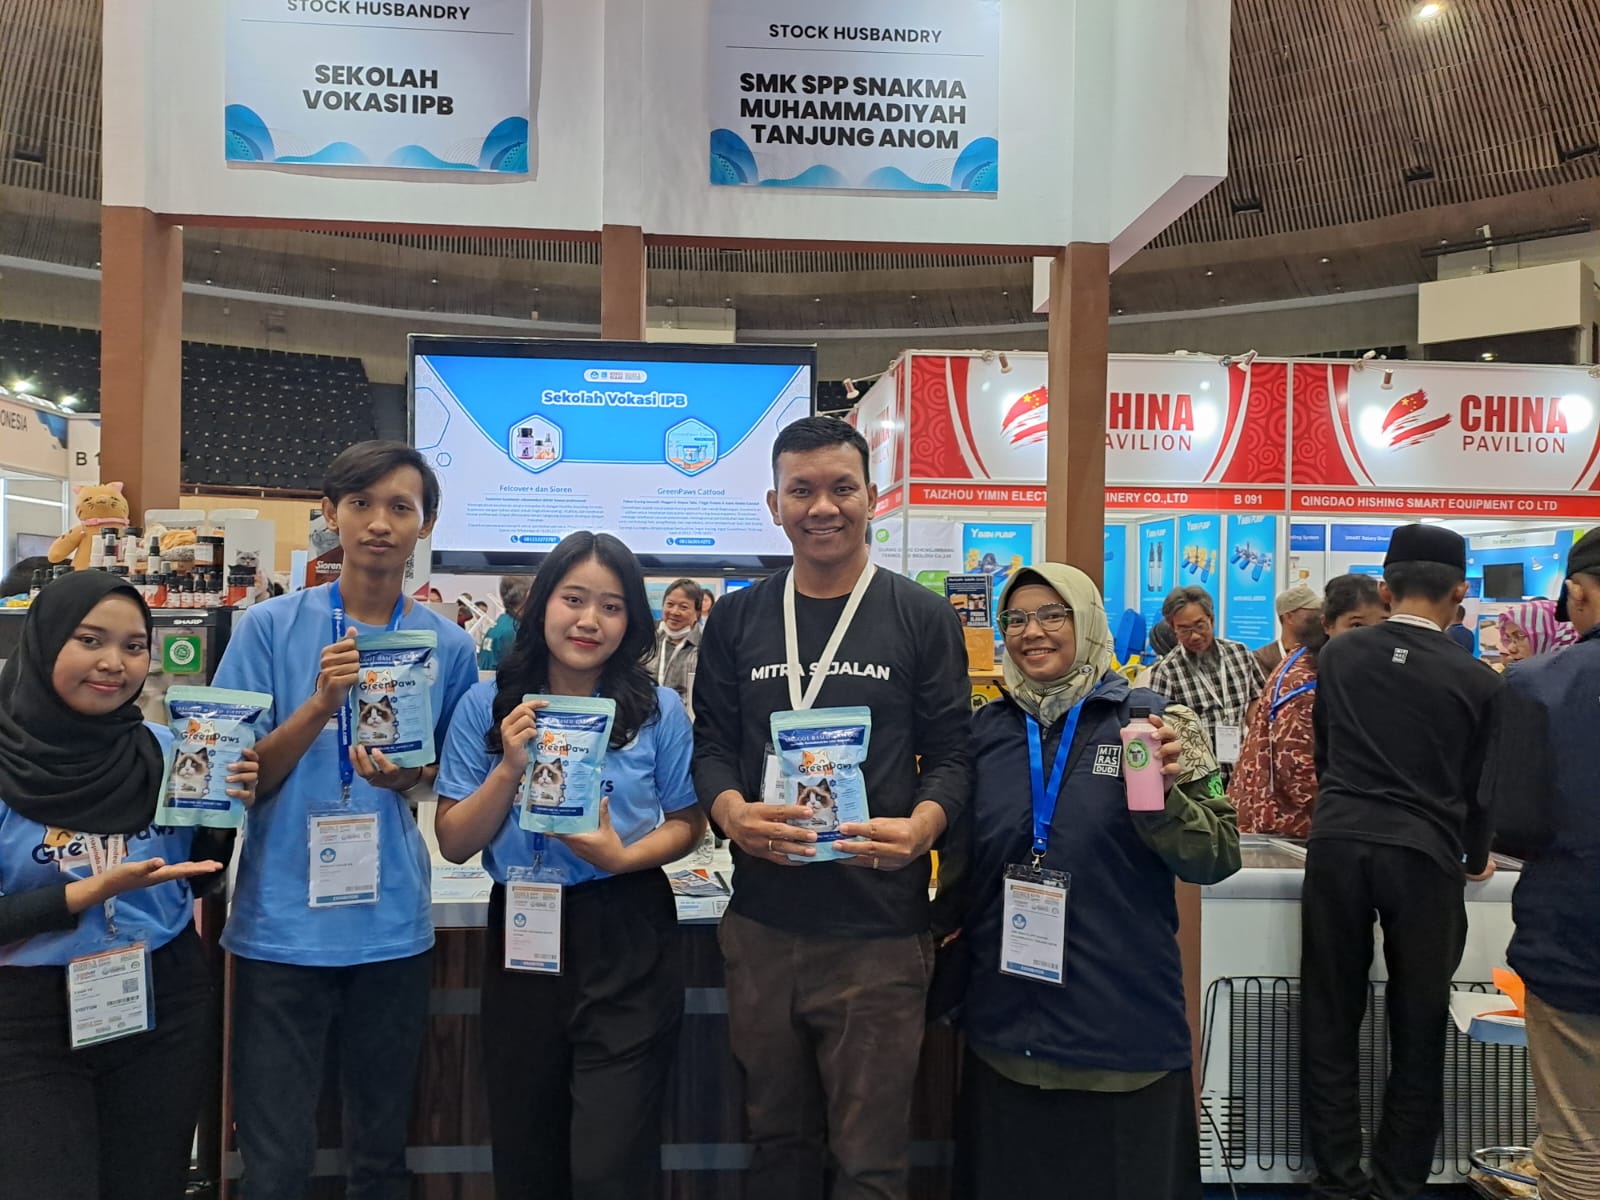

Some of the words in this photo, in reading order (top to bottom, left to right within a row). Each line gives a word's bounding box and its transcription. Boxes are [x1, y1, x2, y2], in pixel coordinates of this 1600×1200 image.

[287, 0, 350, 14] STOCK
[356, 2, 470, 20] HUSBANDRY
[769, 24, 829, 39] STOCK
[834, 27, 942, 43] HUSBANDRY
[315, 64, 438, 89] SEKOLAH
[740, 73, 797, 94] SMK
[802, 75, 849, 96] SPP
[853, 77, 966, 99] SNAKMA
[302, 89, 407, 113] VOKASI
[412, 94, 454, 115] IPB
[740, 98, 966, 124] MUHAMMADIYAH
[751, 125, 874, 147] TANJUNG
[879, 128, 958, 149] ANOM
[543, 391, 604, 405] Sekolah
[606, 392, 657, 406] Vokasi
[660, 394, 686, 407] IPB
[1109, 392, 1195, 431] HINA
[1460, 394, 1568, 434] CHINA
[0, 409, 28, 432] ONESIA
[1105, 433, 1191, 452] AVILION
[1462, 435, 1565, 454] PAVILION
[76, 451, 88, 466] B
[535, 485, 549, 493] dan
[550, 486, 572, 494] Sioren
[657, 487, 696, 496] GreenPaws
[697, 488, 725, 496] Catfood
[923, 488, 974, 500] TAIZHOU
[976, 490, 1009, 501] YIMIN
[1011, 490, 1048, 502] ELECT
[1105, 493, 1141, 503] INERY
[1143, 493, 1189, 505] CO.,LTD
[1234, 494, 1242, 504] B
[1244, 494, 1263, 505] 091
[1301, 495, 1355, 507] QINGDAO
[1357, 497, 1404, 508] HISHING
[1407, 498, 1446, 510] SMART
[1448, 499, 1516, 511] EQUIPMENT
[1517, 500, 1534, 511] CO
[1536, 501, 1558, 511] LTD
[315, 560, 342, 570] Sioren
[809, 661, 890, 681] SJALAN
[360, 679, 416, 691] GreenPaws
[180, 732, 240, 744] GreenPaws
[537, 742, 590, 754] GreenPaws
[1099, 747, 1118, 756] MIT
[1098, 756, 1117, 765] RAS
[1096, 766, 1116, 774] DUDI
